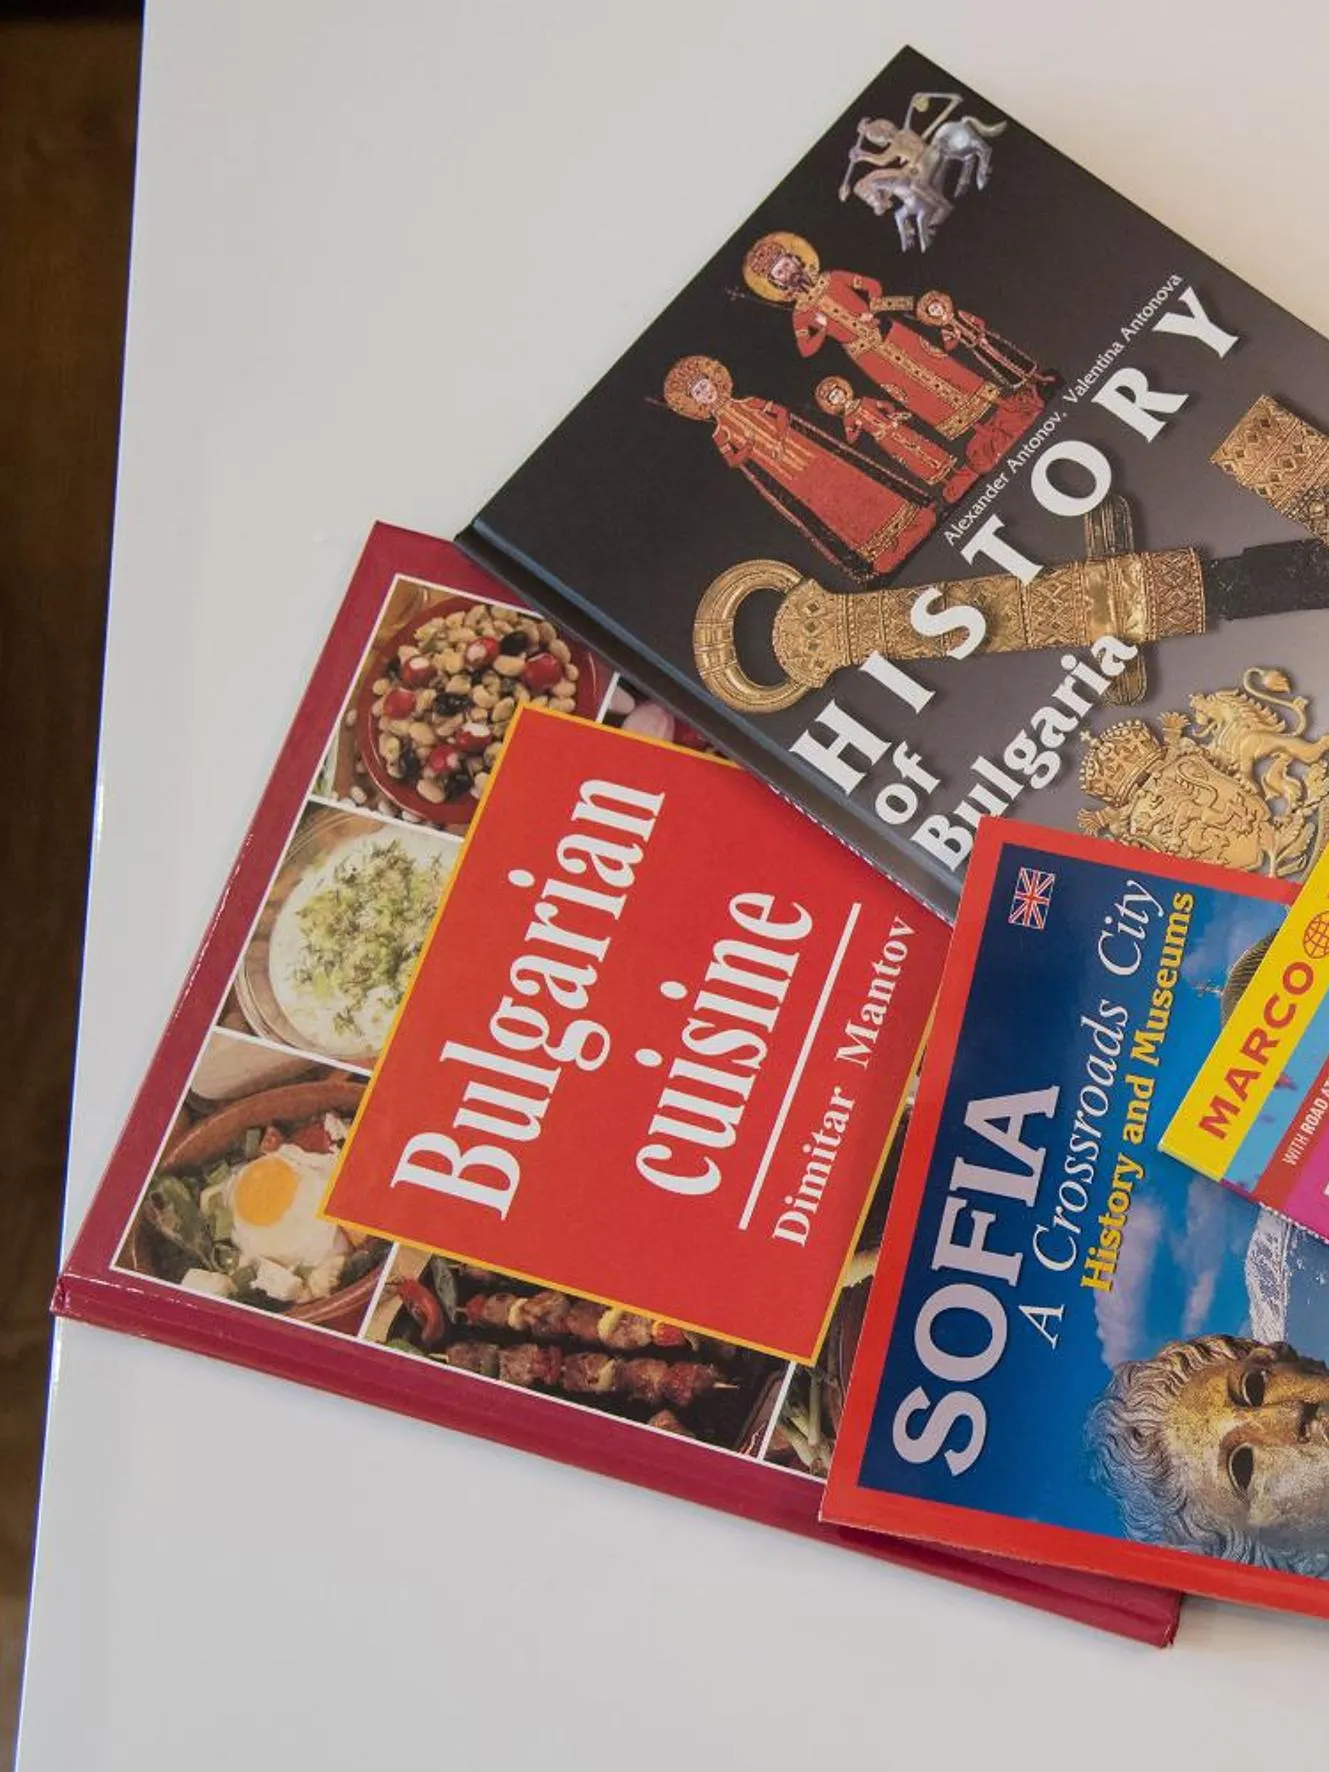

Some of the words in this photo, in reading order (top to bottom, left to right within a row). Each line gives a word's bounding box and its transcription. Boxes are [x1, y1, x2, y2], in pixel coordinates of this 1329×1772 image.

[944, 471, 1010, 546] Alexander
[1063, 340, 1124, 404] Valentina
[1120, 274, 1183, 343] Antonova
[789, 286, 1239, 796] HISTORY
[875, 741, 942, 824] of
[910, 634, 1138, 873] Bulgaria
[390, 779, 666, 1221] Bulgarian
[1098, 879, 1165, 979] City
[1131, 891, 1196, 1065] Museums
[635, 892, 814, 1196] cuisine
[772, 1086, 856, 1247] Dimitar
[834, 916, 917, 1071] Mantov
[1033, 999, 1128, 1273] Crossroads
[1120, 1074, 1156, 1150] and
[1198, 961, 1315, 1140] MARCO
[1281, 1131, 1309, 1166] WITH
[1299, 1096, 1329, 1135] ROAD
[892, 1084, 1061, 1477] SOFIA
[1017, 1304, 1064, 1348] A
[1080, 1152, 1146, 1292] History
